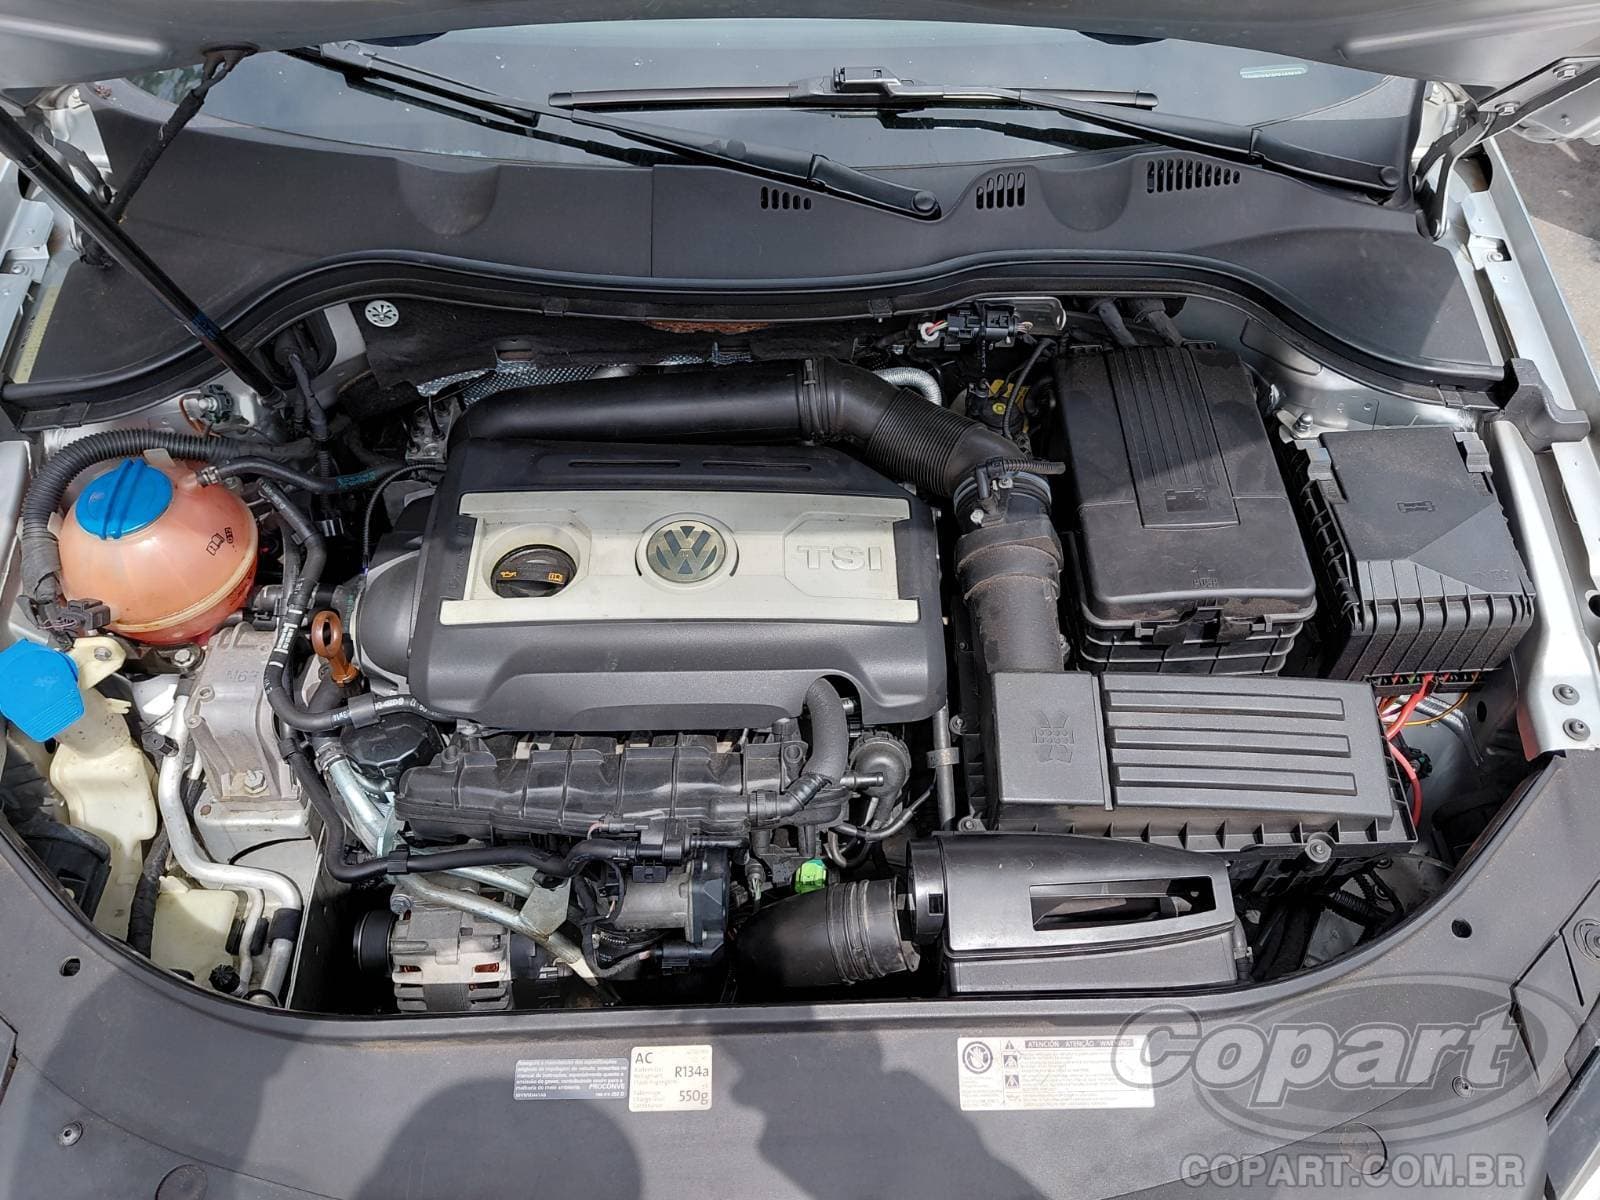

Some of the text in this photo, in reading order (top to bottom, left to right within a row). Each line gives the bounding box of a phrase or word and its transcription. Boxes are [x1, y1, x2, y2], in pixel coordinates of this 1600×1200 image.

[796, 544, 882, 573] TSI
[634, 1052, 654, 1065] AC
[674, 1065, 709, 1079] R134a
[679, 1089, 709, 1105] 550g
